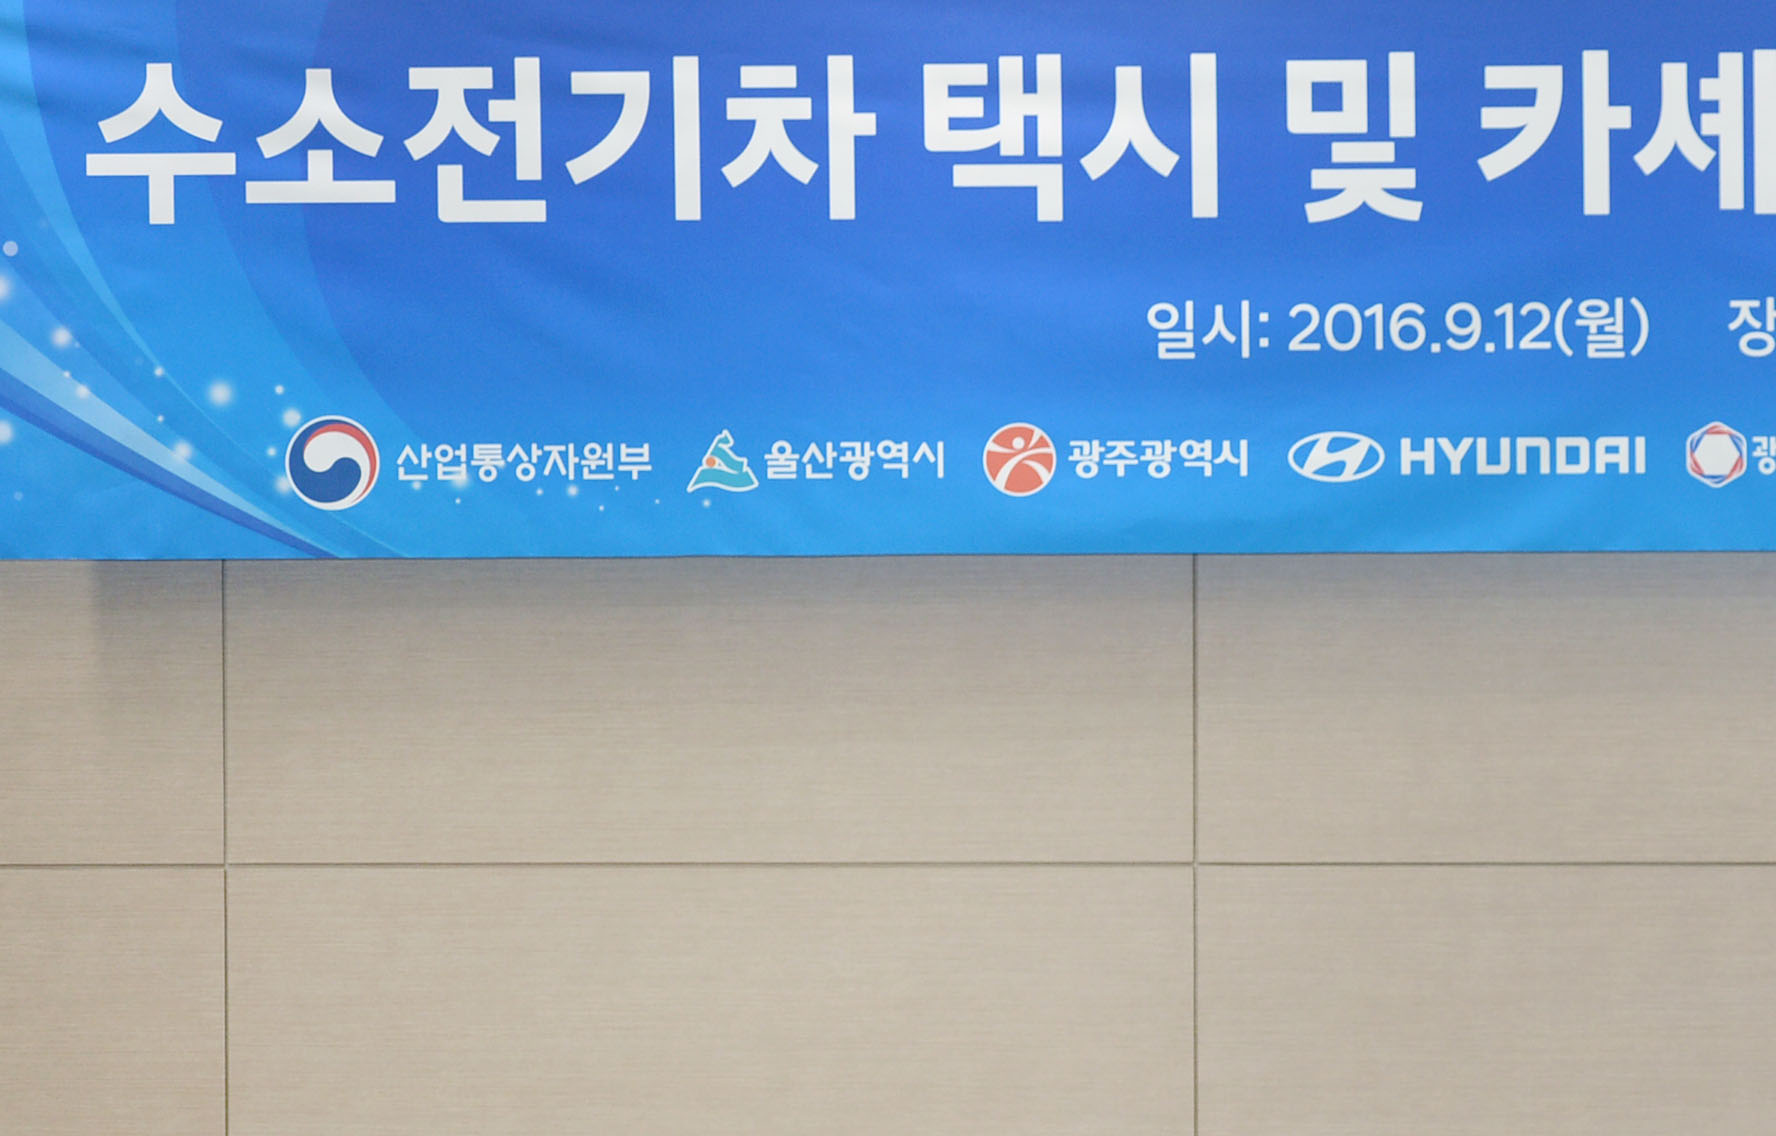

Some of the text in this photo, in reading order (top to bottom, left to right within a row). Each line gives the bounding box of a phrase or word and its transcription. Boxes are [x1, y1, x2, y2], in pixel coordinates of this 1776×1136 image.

[86, 55, 876, 224] 수소전기차
[924, 53, 1218, 221] 택시
[1286, 52, 1422, 222] 및
[1148, 300, 1268, 359] 일시:
[1289, 298, 1648, 357] 2016.9.12(월)
[398, 442, 651, 481] 산업통상자원부
[765, 440, 944, 480] 울산광역시
[1069, 440, 1247, 478] 광주광역시
[1401, 437, 1645, 474] HYUNDAI
